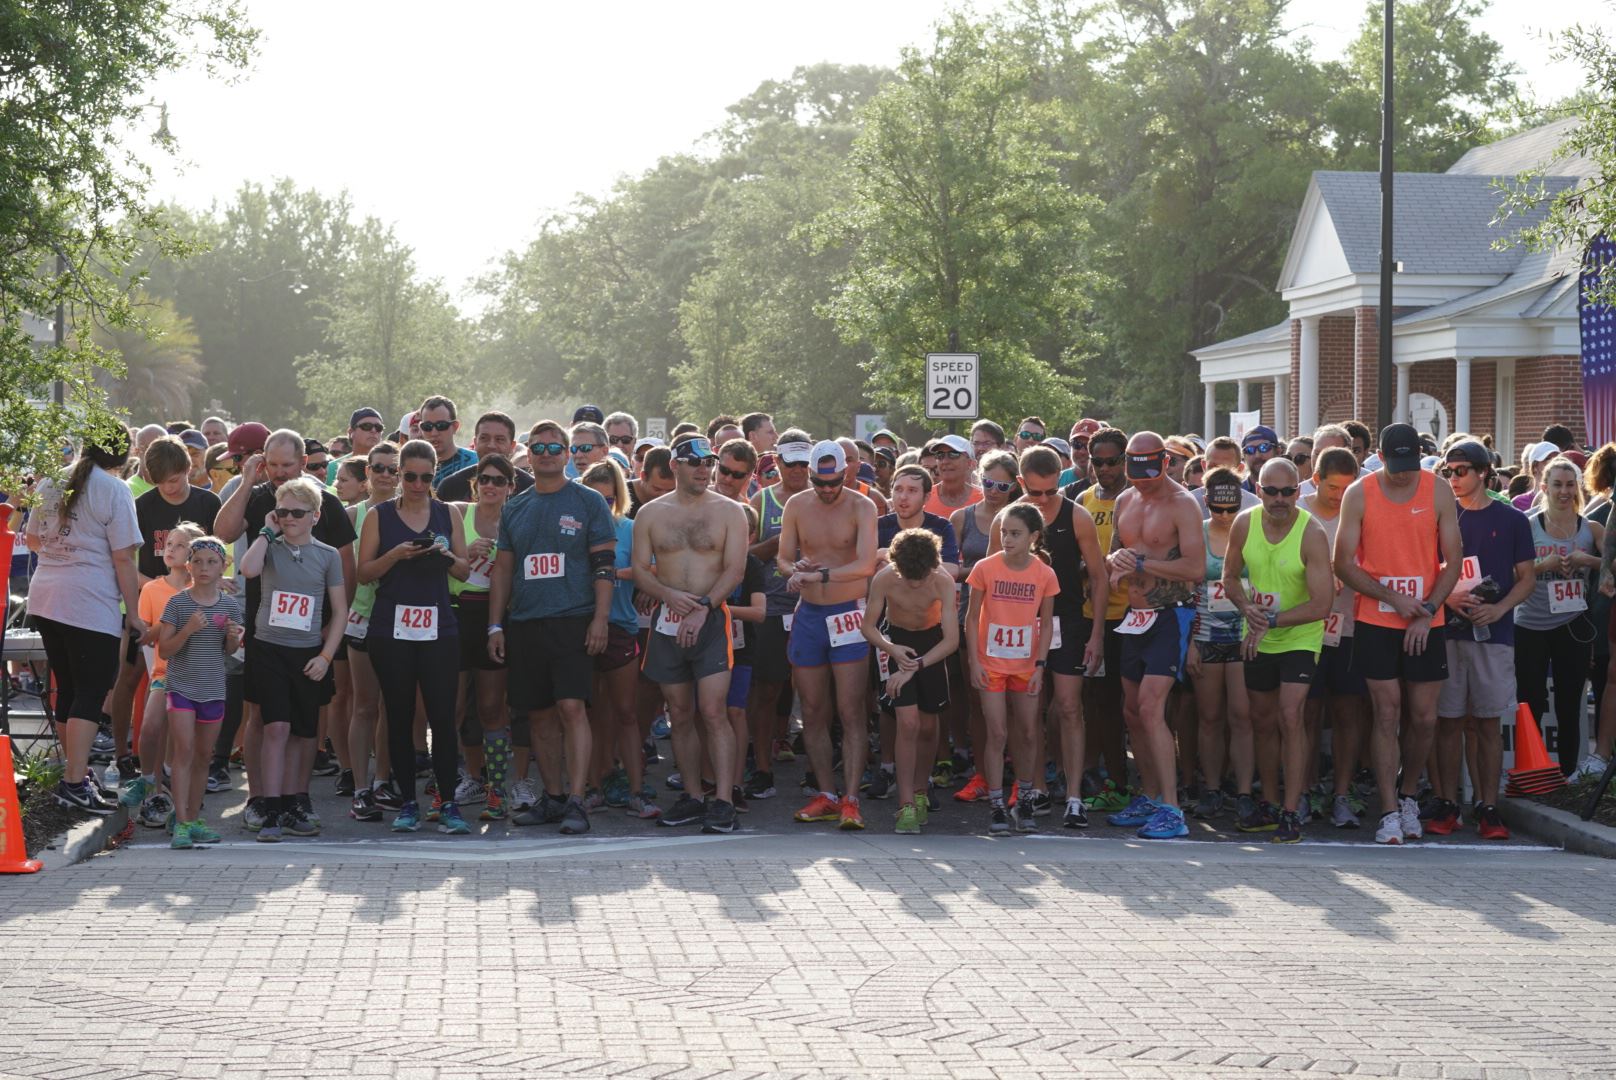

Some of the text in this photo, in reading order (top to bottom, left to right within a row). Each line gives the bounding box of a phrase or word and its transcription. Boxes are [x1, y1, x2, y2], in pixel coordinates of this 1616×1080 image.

[932, 362, 973, 371] SPEED
[936, 375, 969, 384] LIMIT
[932, 387, 972, 410] 20
[530, 554, 560, 576] 309
[993, 580, 1036, 597] TOUGHER
[1554, 581, 1582, 602] 544
[277, 593, 310, 617] 578
[401, 607, 432, 629] 428
[1127, 610, 1154, 628] 397
[993, 627, 1026, 648] 411
